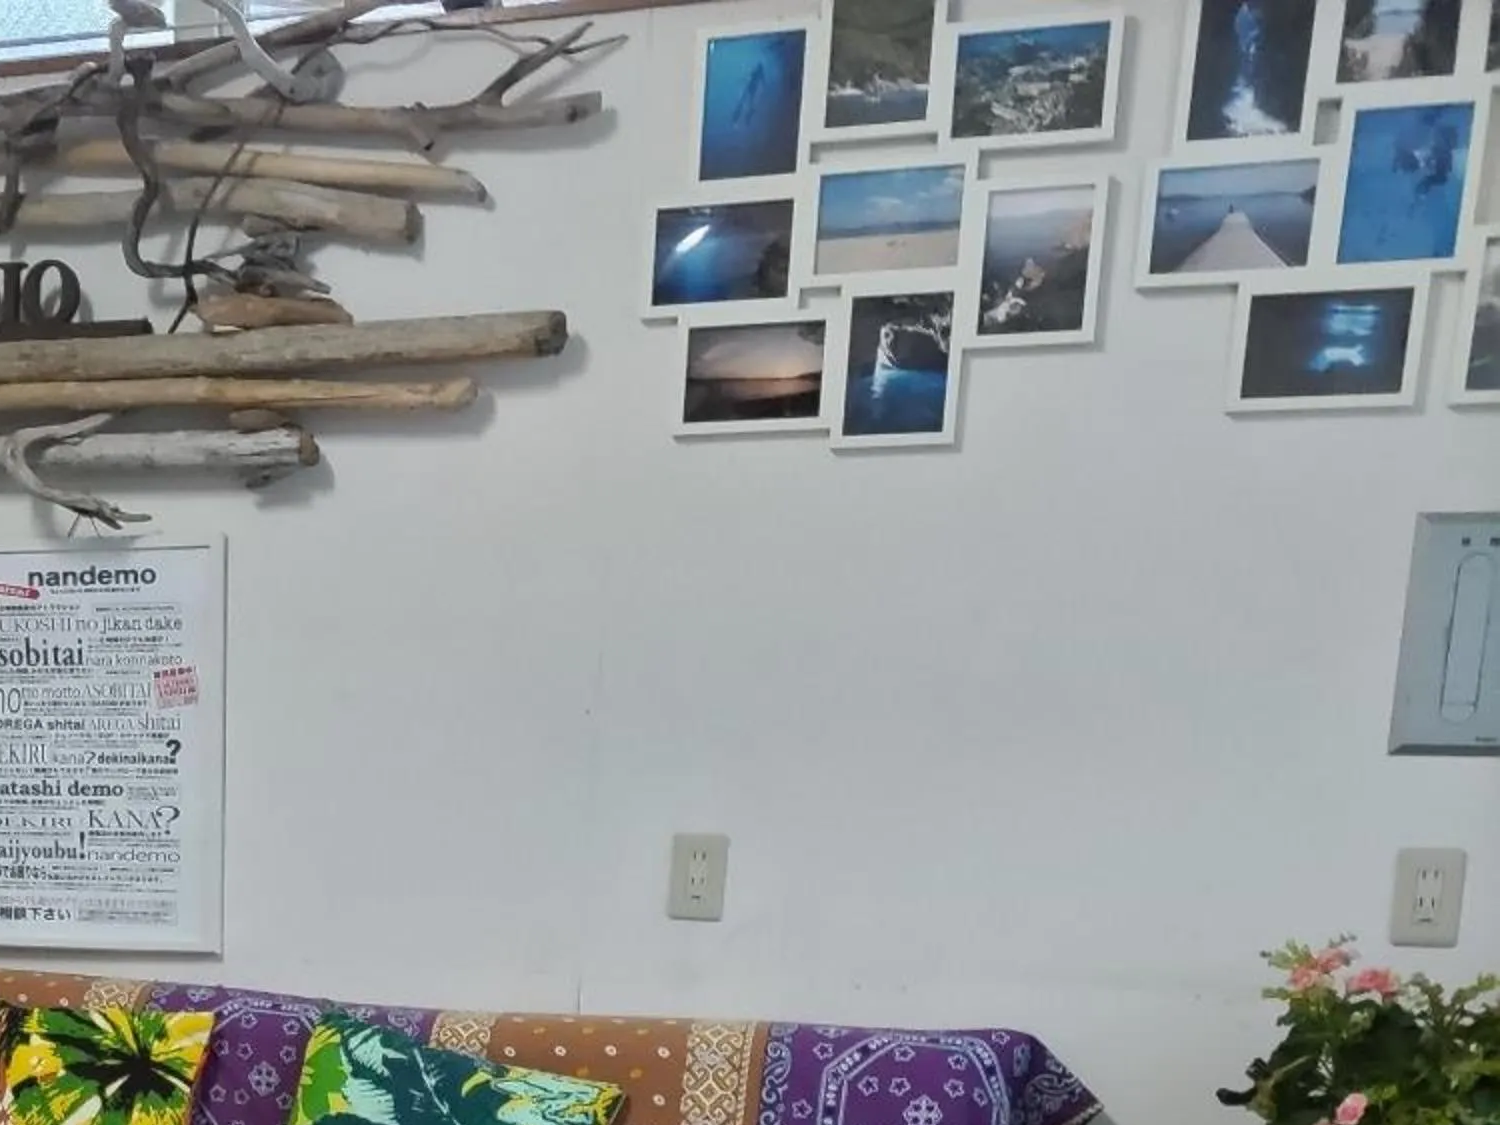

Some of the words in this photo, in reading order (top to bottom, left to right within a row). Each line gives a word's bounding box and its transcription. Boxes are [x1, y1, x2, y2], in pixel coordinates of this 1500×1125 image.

[27, 565, 156, 587] nandemo
[75, 620, 99, 632] no
[101, 616, 142, 634] jikan
[144, 615, 184, 631] dake
[48, 718, 85, 731] shitai
[67, 780, 124, 797] demo
[87, 849, 181, 864] nandemo
